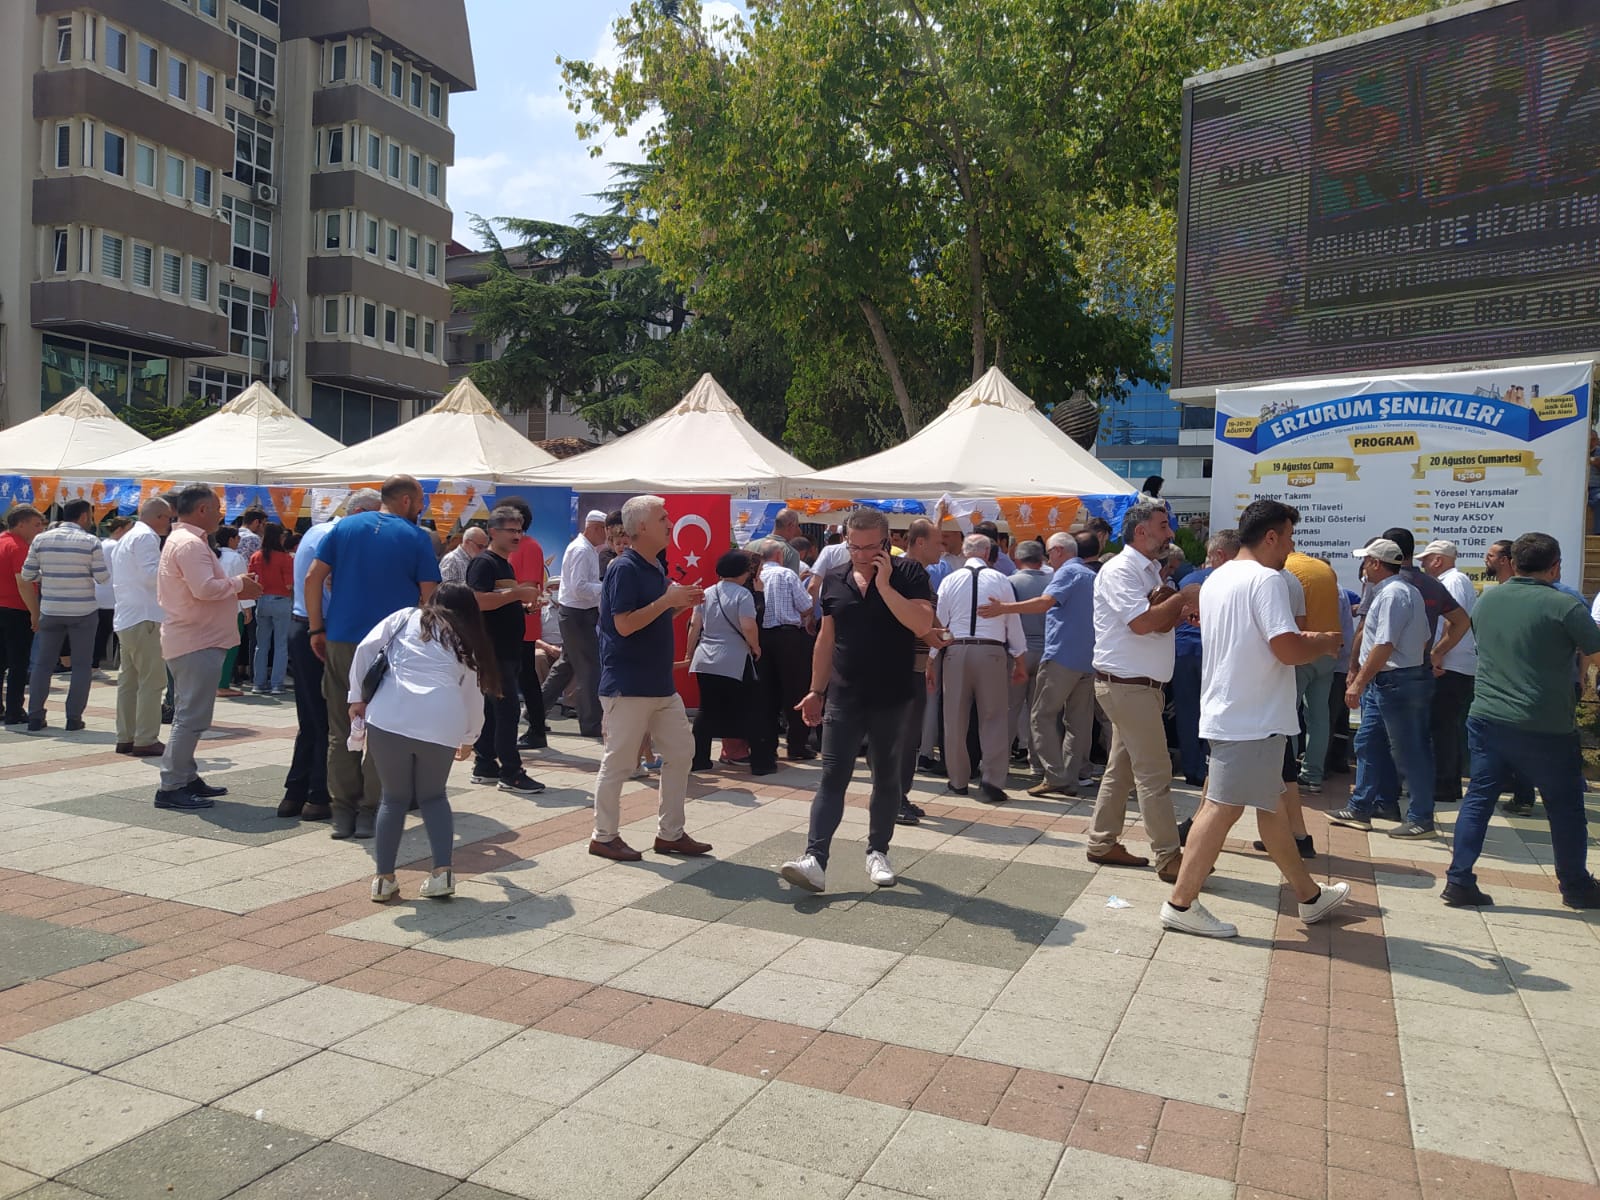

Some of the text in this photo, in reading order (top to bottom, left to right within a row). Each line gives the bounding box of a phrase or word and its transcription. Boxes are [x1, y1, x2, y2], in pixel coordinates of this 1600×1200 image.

[1270, 396, 1505, 439] ERZURUM ŞENLİKLERİ
[1354, 434, 1414, 448] PROGRAM
[1430, 453, 1522, 466] 20 Ağustos Cumartesi
[1273, 461, 1334, 472] 19 Ağustos Cuma
[1456, 472, 1481, 480] 15:00
[1254, 492, 1311, 501] Mehter Takımı
[1435, 488, 1518, 497] Yöresel Yarışmalar
[1312, 503, 1343, 511] Tilaveti
[1434, 501, 1505, 510] Teyo PEHLİVAN
[1304, 515, 1326, 523] Ekibi
[1328, 514, 1366, 523] Gösterisi
[1433, 513, 1495, 522] Nuray AKSOY
[1433, 525, 1503, 534] Mustafa ÖZDEN
[1297, 539, 1351, 547] Konuşmaları
[1462, 537, 1487, 546] TÜRE
[1321, 550, 1349, 558] Fatma
